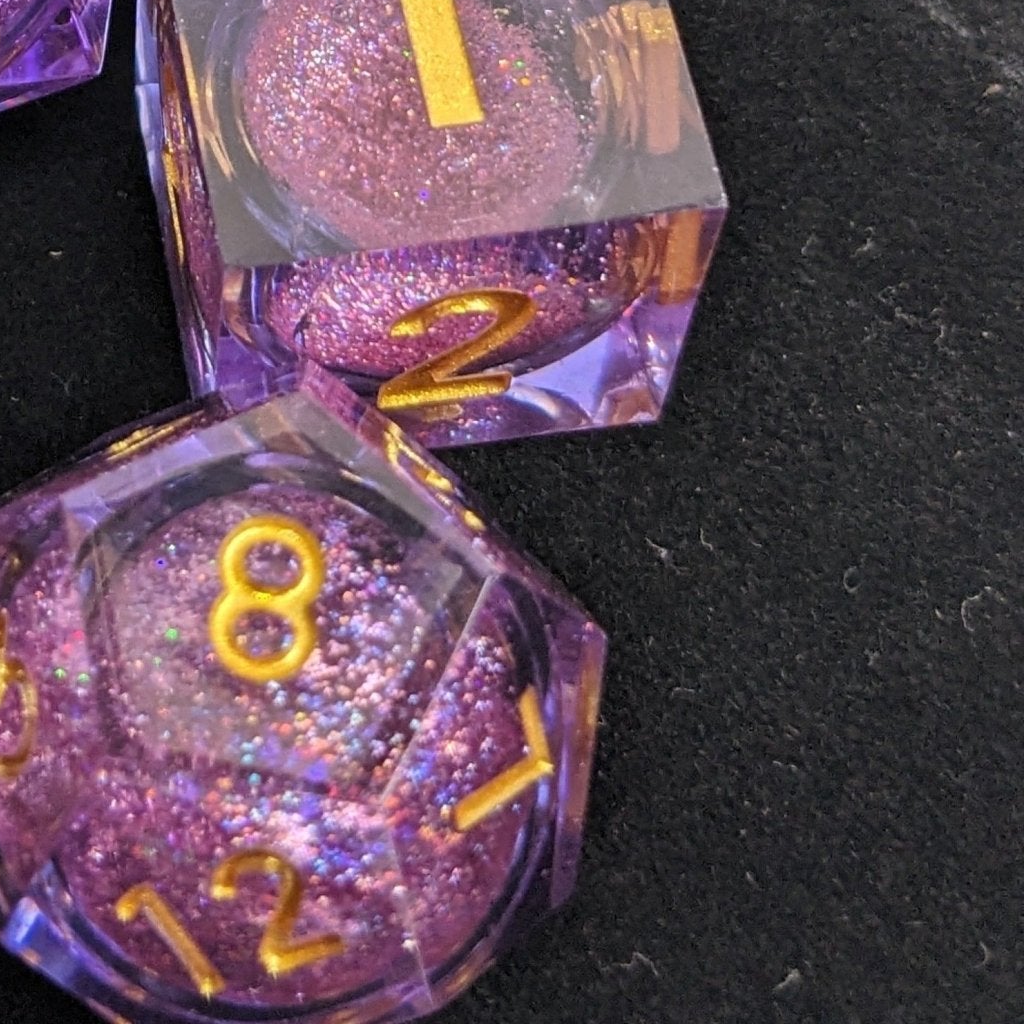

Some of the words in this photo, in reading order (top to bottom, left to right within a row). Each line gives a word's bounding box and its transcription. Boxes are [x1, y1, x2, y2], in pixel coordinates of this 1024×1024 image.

[378, 288, 539, 410] 2
[208, 514, 325, 684] 8
[451, 685, 554, 832] 7
[116, 849, 346, 999] 12
